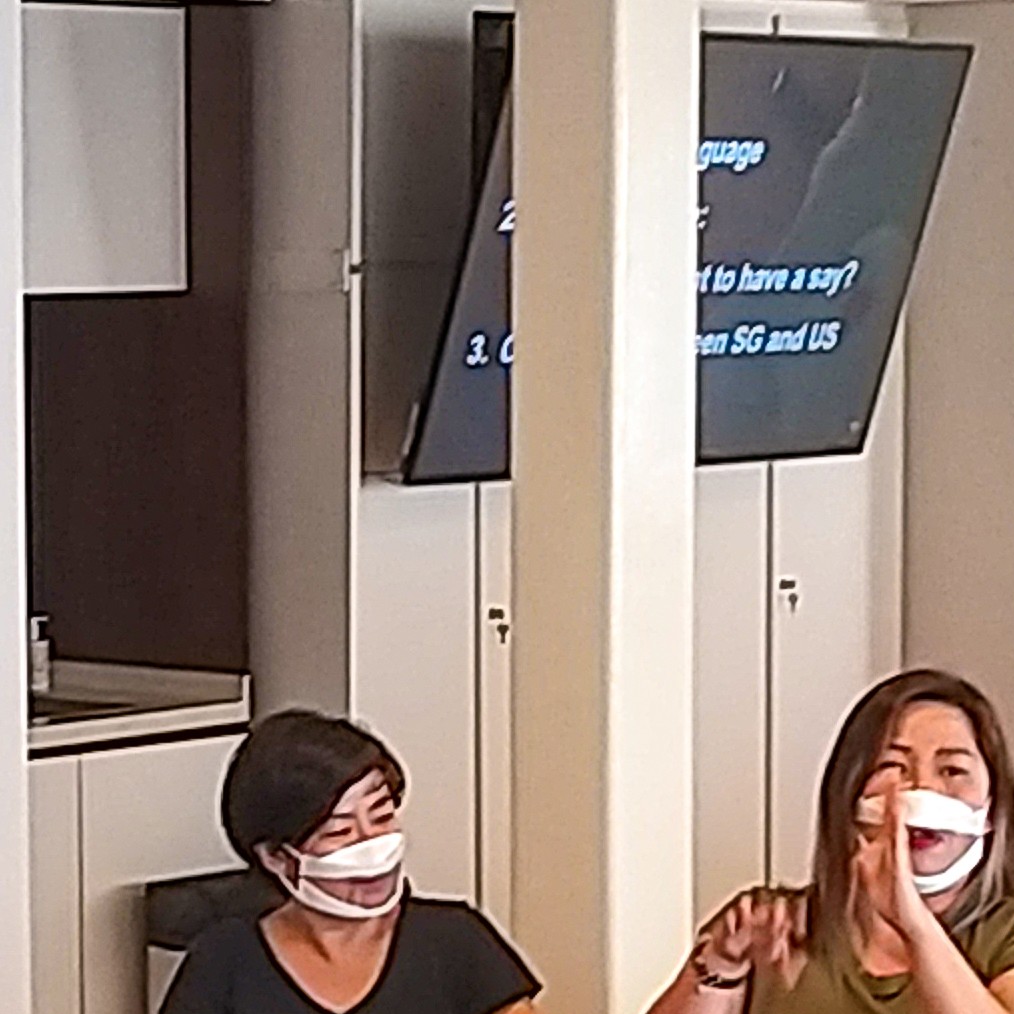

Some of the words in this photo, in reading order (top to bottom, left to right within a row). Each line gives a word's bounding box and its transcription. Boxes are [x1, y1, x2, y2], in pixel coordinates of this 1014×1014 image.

[712, 264, 736, 293] to
[736, 262, 790, 292] have
[790, 266, 806, 291] a
[806, 259, 860, 297] say?
[466, 333, 489, 366] 3.
[730, 323, 766, 355] SG
[765, 322, 809, 353] and
[808, 320, 842, 352] US
